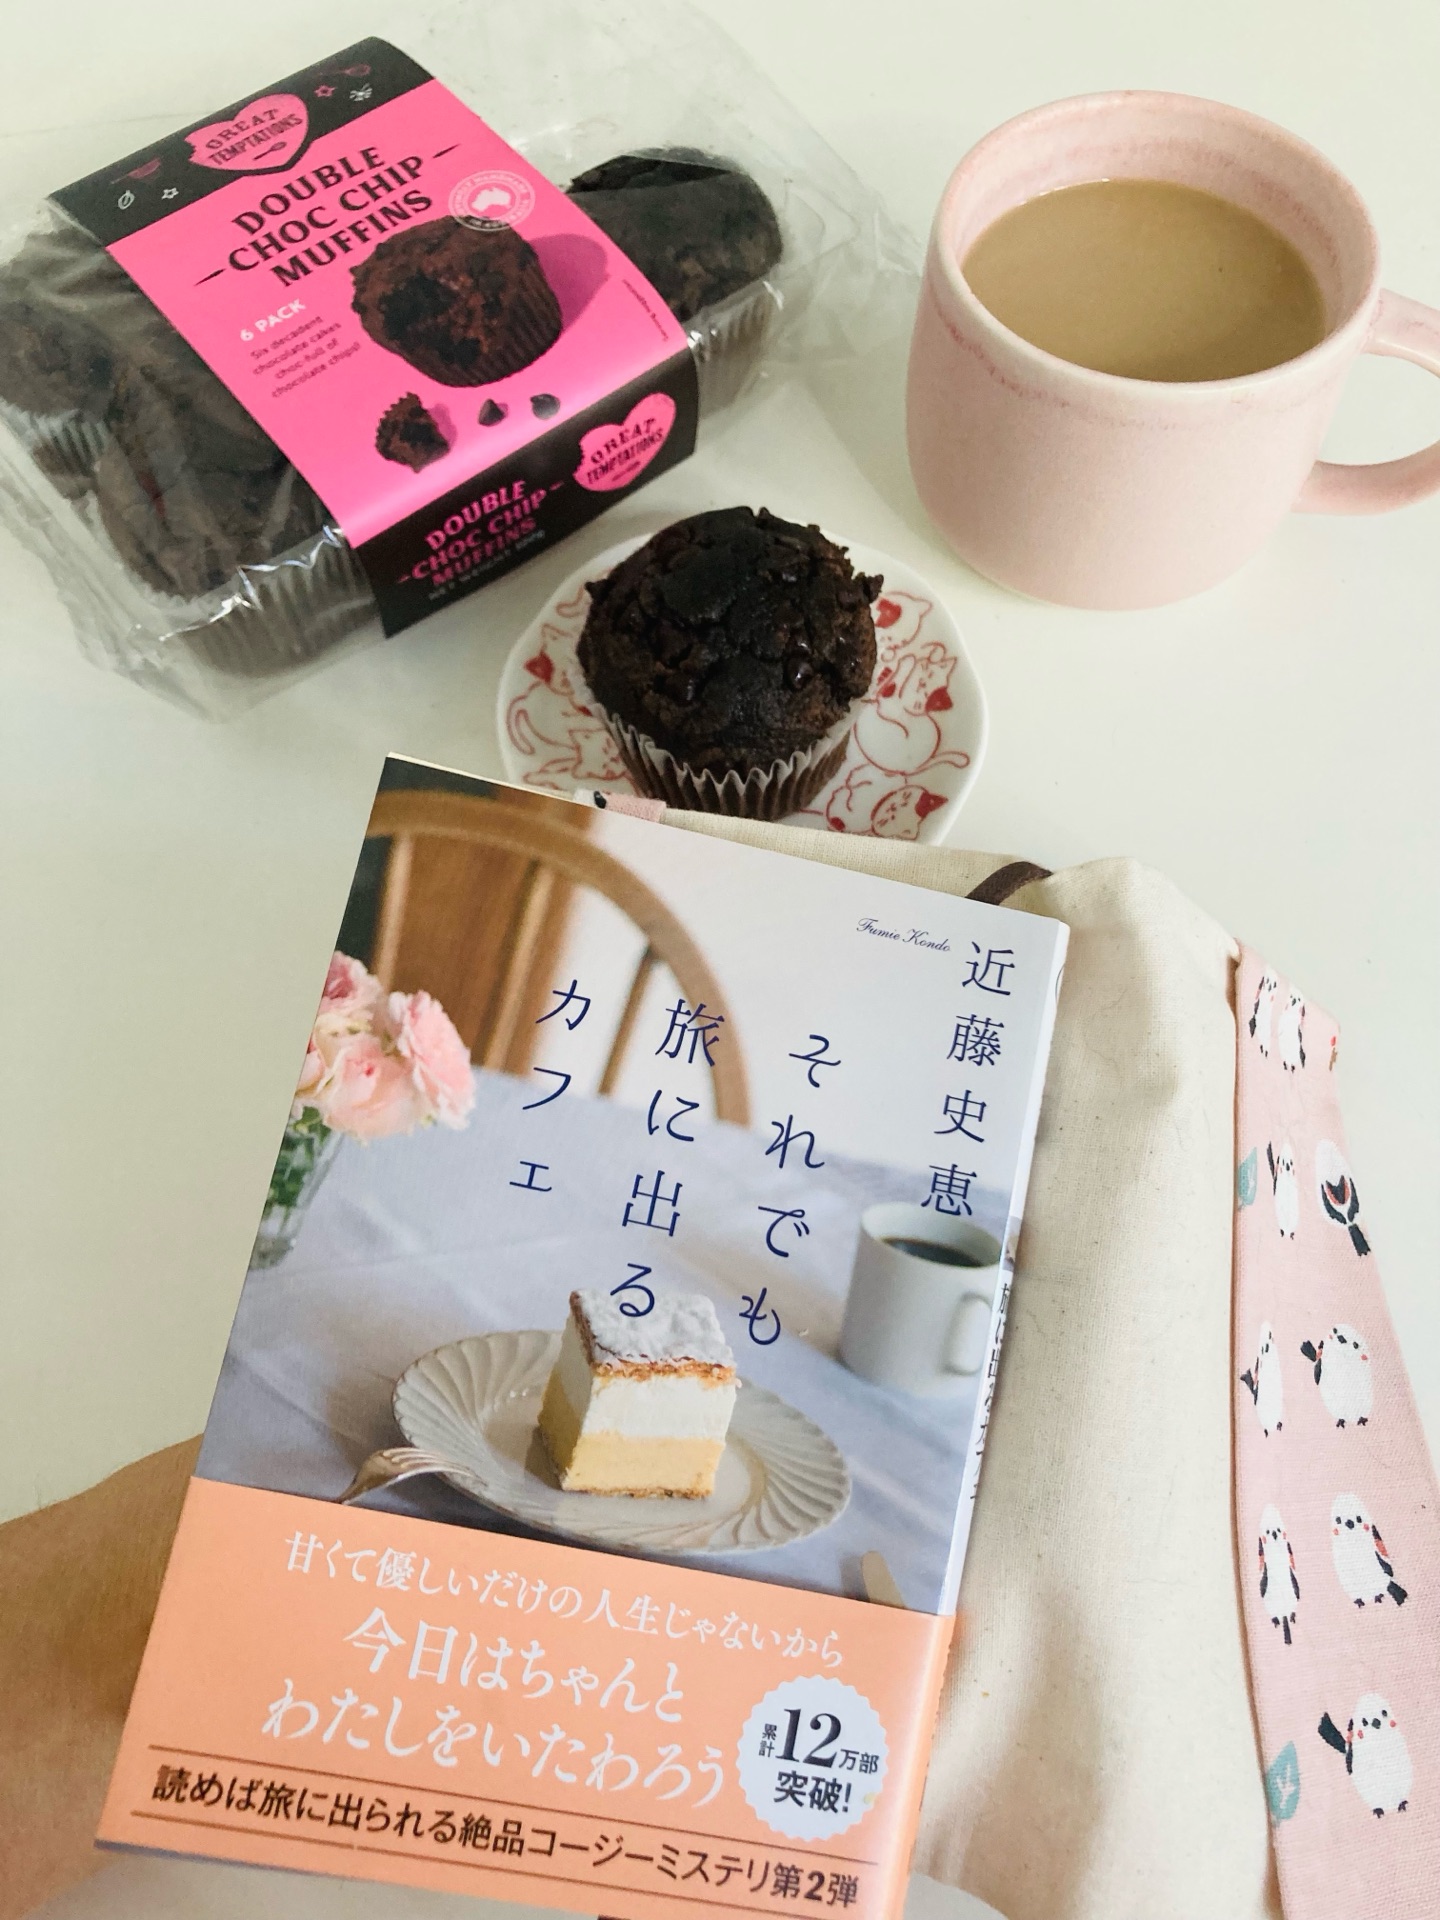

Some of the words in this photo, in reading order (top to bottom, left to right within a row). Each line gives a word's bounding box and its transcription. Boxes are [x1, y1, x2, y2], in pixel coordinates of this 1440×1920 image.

[206, 109, 279, 150] GREAT
[208, 113, 303, 165] TEMPTATIONS
[228, 206, 338, 271] CHOC
[338, 155, 424, 212] CHIP
[232, 147, 385, 235] DOUBLE
[271, 190, 432, 287] MUFFINS
[240, 329, 254, 341] 6
[254, 299, 306, 332] PACK
[253, 341, 309, 375] chocolate
[271, 363, 327, 398] chocolate
[591, 417, 656, 464] GREAT
[411, 528, 482, 580] CHOC
[487, 489, 548, 535] CHIP
[424, 479, 526, 551] DOUBLE
[432, 516, 537, 586] MUFFINS
[856, 917, 901, 942] Fumie
[902, 928, 951, 953] Kondo
[508, 979, 592, 1193] カフェ
[920, 941, 1016, 1217] 近藤史恵
[609, 998, 726, 1318] 旅に出る
[739, 1034, 842, 1346] それでも
[285, 1530, 845, 1668] 甘くて優しいだけの人生じゃないから
[342, 1606, 686, 1724] 今日はちゃんと
[260, 1678, 728, 1809] わたしをいたわろう
[151, 1762, 861, 1909] 読めば旅に出られる絶品コージーミステリ第2弾
